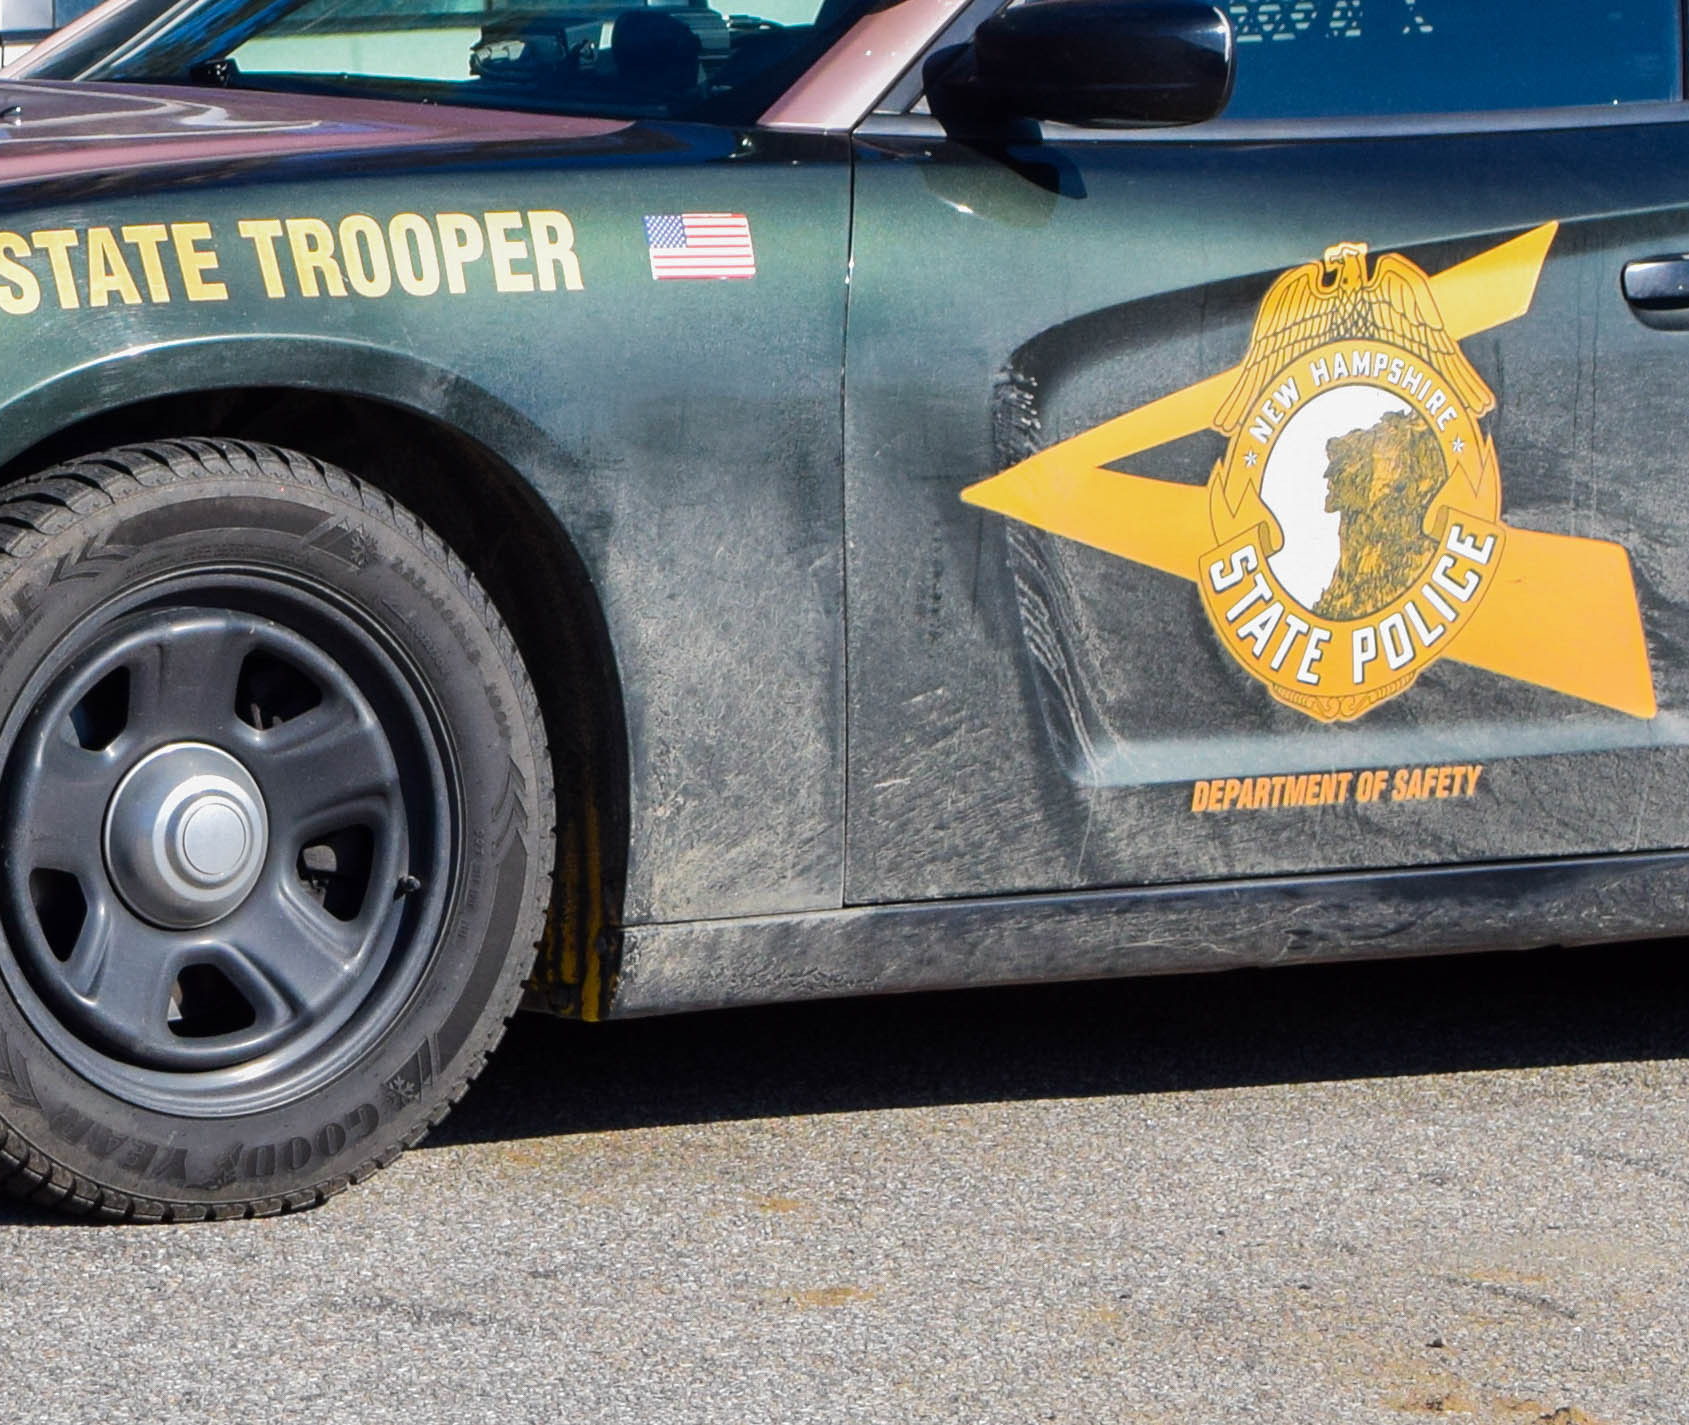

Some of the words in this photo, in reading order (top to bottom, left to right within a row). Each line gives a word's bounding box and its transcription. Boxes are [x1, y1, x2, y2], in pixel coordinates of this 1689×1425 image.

[238, 210, 585, 299] TROOPER
[1249, 376, 1301, 444] NEW
[1309, 350, 1457, 431] HAMPSHIRE
[1209, 544, 1332, 685] STATE
[1351, 523, 1496, 685] POLICE
[1191, 772, 1353, 812] DEPARTMENT
[1356, 771, 1390, 802] OF
[1391, 765, 1484, 801] SAFETY
